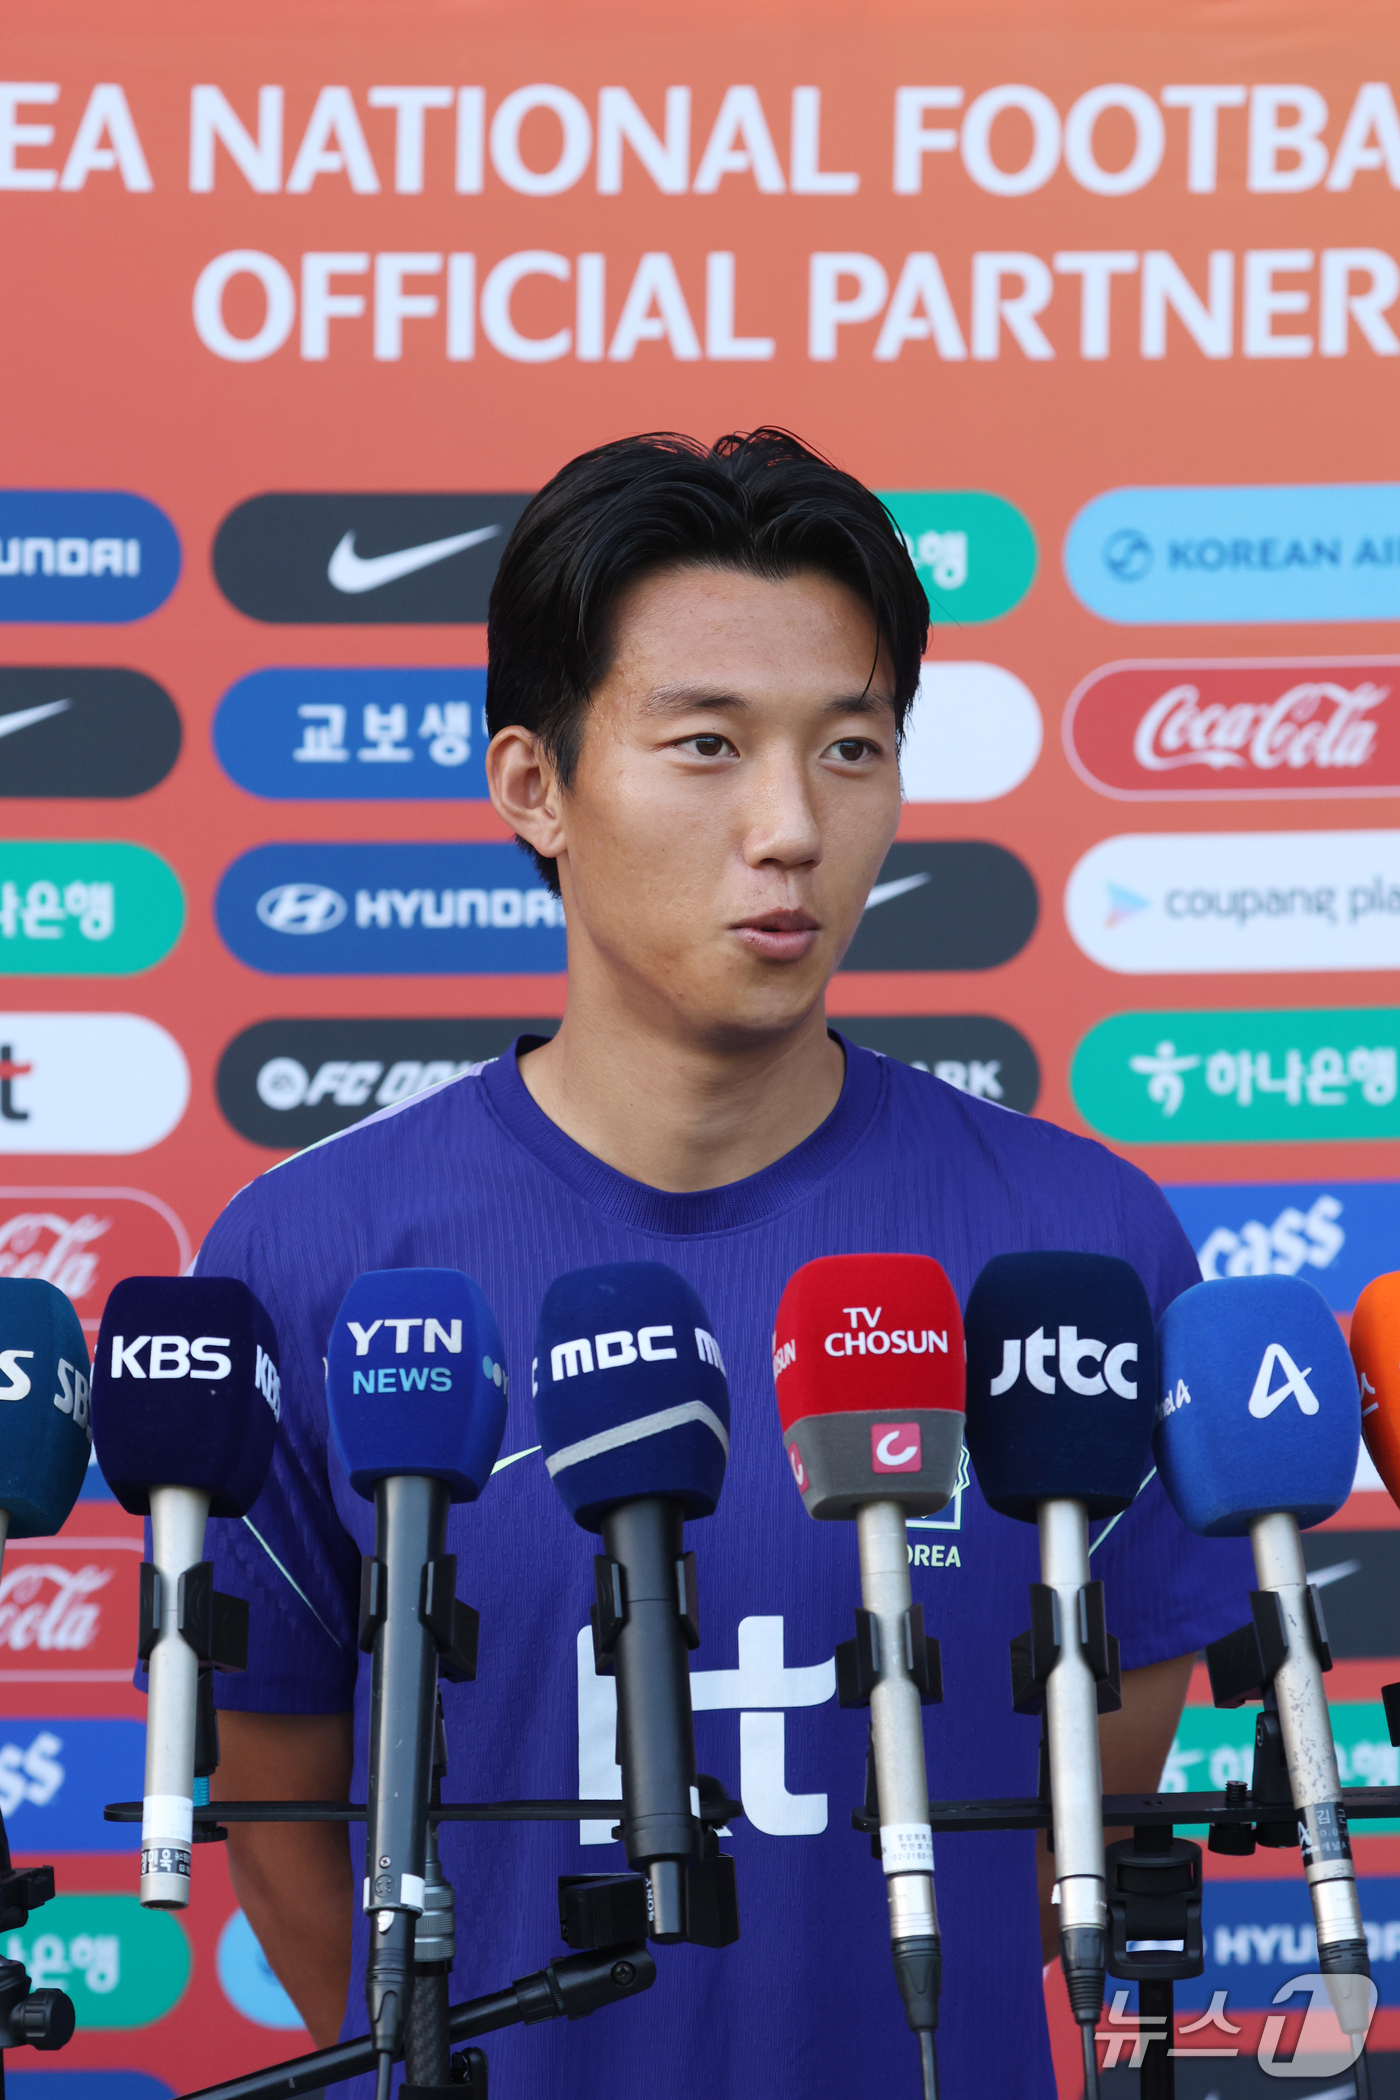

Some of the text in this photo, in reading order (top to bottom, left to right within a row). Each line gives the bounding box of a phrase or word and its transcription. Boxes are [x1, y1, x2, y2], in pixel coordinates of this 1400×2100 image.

[188, 83, 860, 197] NATIONAL
[893, 82, 1400, 197] FOOTBA
[191, 247, 1400, 362] OFFICIAL PARTNER
[1167, 537, 1342, 572] KOREAN
[292, 702, 488, 767] 교보생
[1165, 884, 1338, 929] coupang
[304, 1060, 385, 1107] FC
[1205, 1045, 1398, 1107] 하나은행
[346, 1318, 462, 1356] YTN
[842, 1306, 882, 1329] TV
[111, 1335, 232, 1380] KBS
[550, 1325, 677, 1382] MBC
[824, 1330, 949, 1358] CHOSUN
[353, 1367, 452, 1395] NEWS
